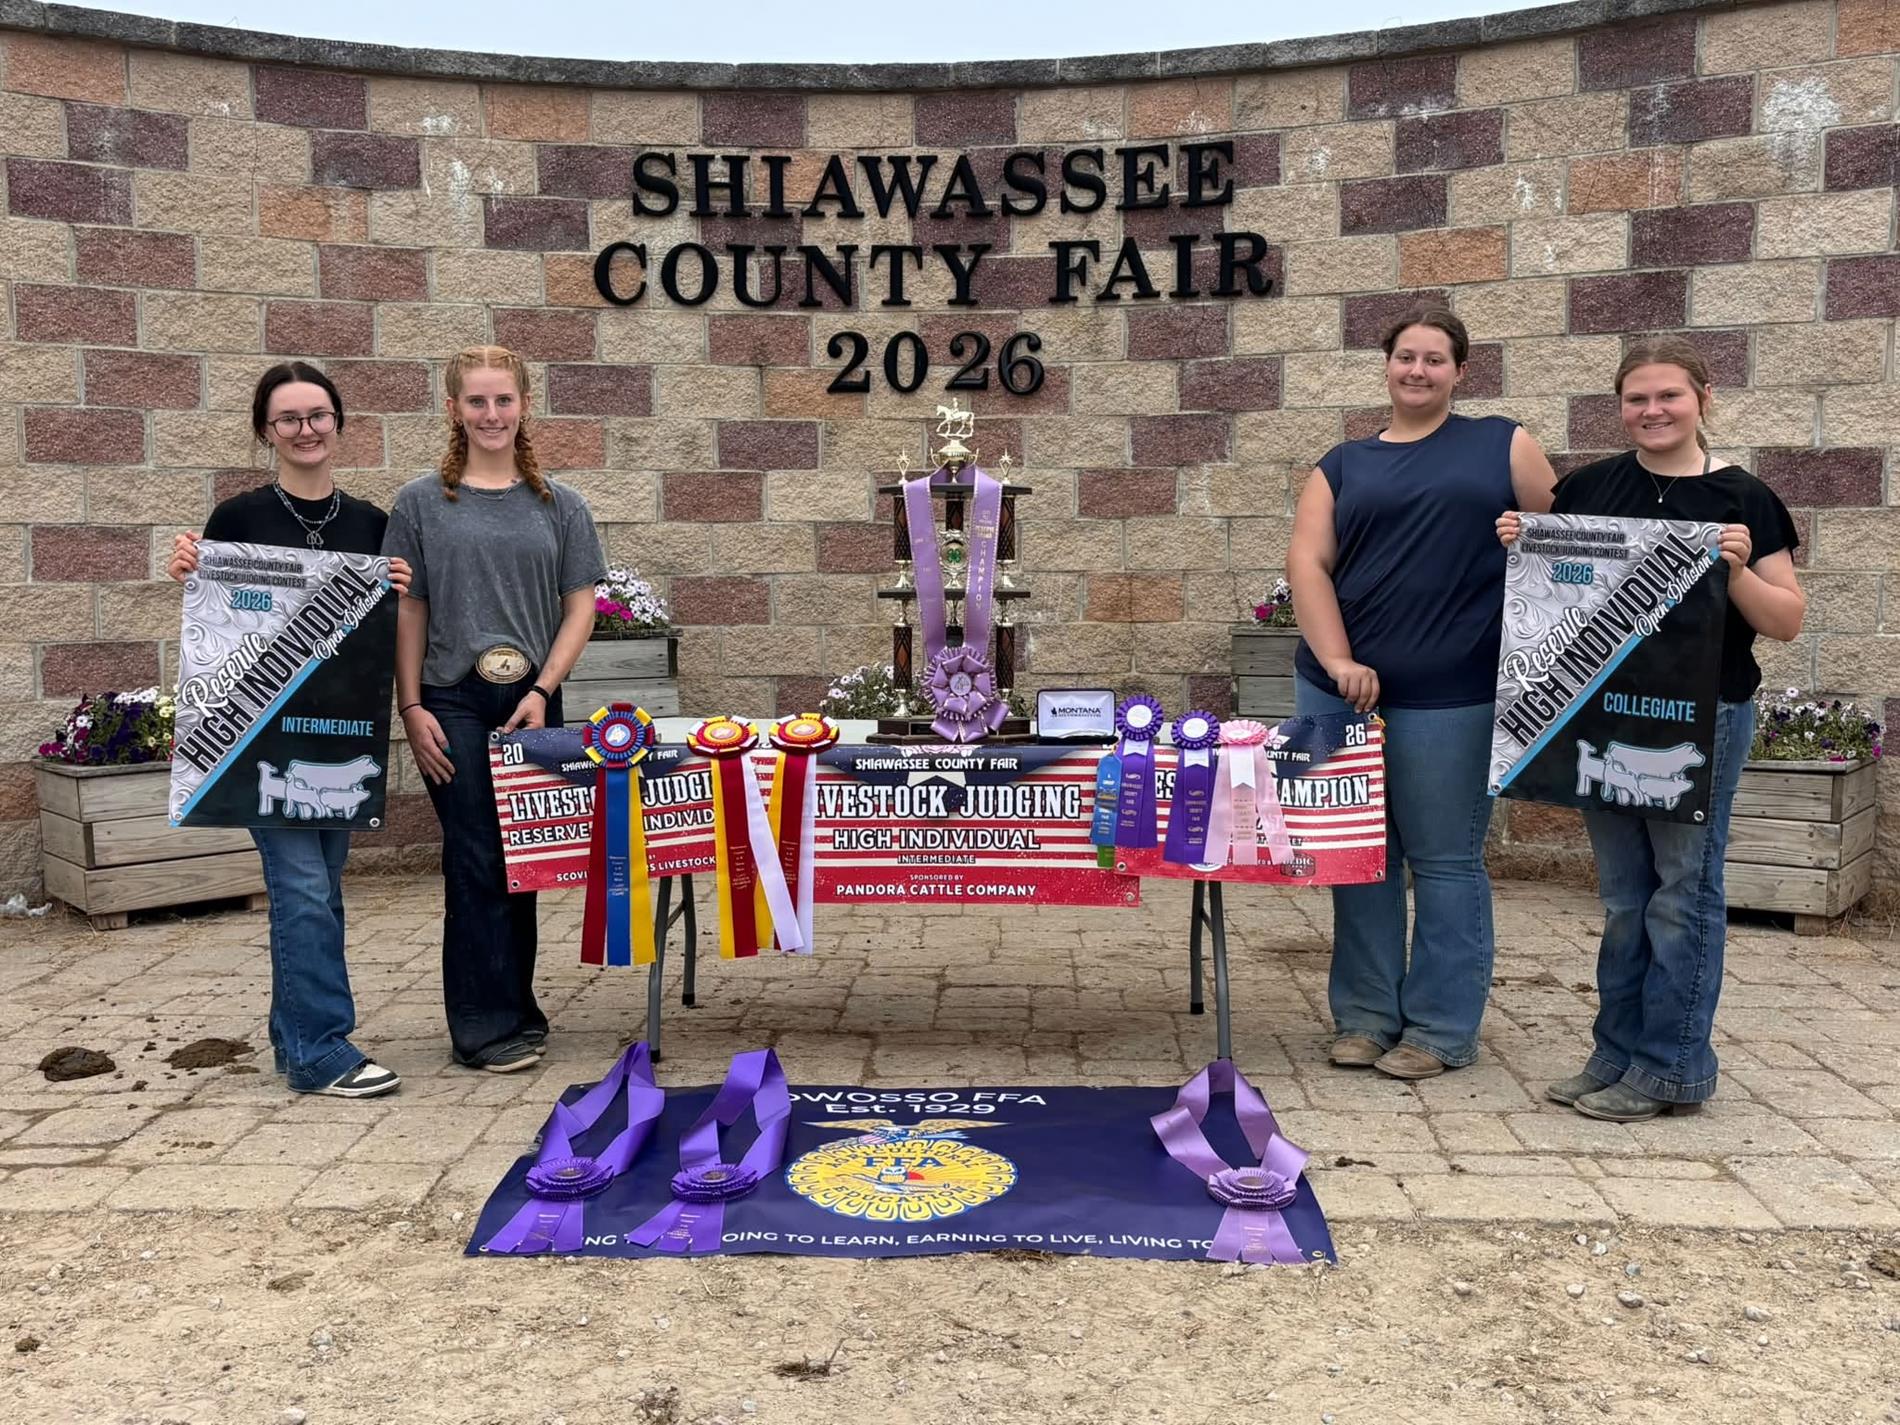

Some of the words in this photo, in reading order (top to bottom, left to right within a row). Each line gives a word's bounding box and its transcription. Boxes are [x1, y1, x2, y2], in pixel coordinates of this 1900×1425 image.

[632, 141, 1235, 219] SHIAWASSEE
[593, 241, 993, 308] COUNTY
[1047, 231, 1273, 301] FAIR
[826, 331, 1046, 395] 2026
[1527, 528, 1574, 540] SHIAWASSEE
[1576, 531, 1606, 543] COUNTY
[1607, 533, 1626, 544] FAIR
[1521, 543, 1560, 554] LIVESTOCK
[1562, 546, 1593, 557] JUDGING
[1594, 548, 1629, 559] CONTEST
[203, 555, 252, 568] SHIAWASSEE
[254, 558, 284, 572] COUNTY
[285, 562, 304, 574] FAIR
[1552, 562, 1593, 585] 2026
[199, 570, 238, 581] LIVESTOCK
[272, 577, 307, 589] CONTEST
[231, 589, 272, 612] 2026
[1634, 603, 1669, 636] Open
[1667, 556, 1714, 604] Division
[312, 628, 347, 660] Open
[344, 587, 386, 629] Division
[1498, 674, 1576, 748] HIGH
[1555, 532, 1707, 687] INDIVIDUAL
[1504, 607, 1587, 692] Reserve
[178, 697, 254, 774] HIGH
[235, 565, 380, 710] INDIVIDUAL
[181, 632, 268, 717] Reserve
[1603, 692, 1696, 723] COLLEGIATE
[282, 716, 374, 737] INTERMEDIATE
[1345, 723, 1366, 746] 26
[503, 742, 524, 765] 20
[657, 749, 679, 760] FAIR
[855, 758, 929, 771] SHIAWASSEE
[935, 757, 985, 770] COUNTY
[990, 757, 1018, 770] FAIR
[1266, 750, 1289, 761] UNTY
[1291, 752, 1311, 763] FAIR
[561, 760, 598, 772] SHIAWA
[509, 785, 597, 821] LIVEST
[643, 771, 713, 806] JUDGI
[815, 784, 948, 818] IVESTOCK
[959, 784, 1081, 818] JUDGING
[1274, 774, 1369, 808] AMPION
[509, 822, 590, 846] RESERVE
[643, 808, 715, 831] INDIVID
[834, 829, 892, 849] HIGH
[899, 829, 1040, 849] INDIVIDUAL
[658, 855, 716, 871] LIVESTOCK
[897, 855, 976, 864] INTERMEDIATE
[556, 870, 588, 882] SCOVI
[836, 884, 906, 896] PANDORA
[910, 884, 962, 896] CATTLE
[966, 884, 1036, 897] COMPANY
[825, 1103, 897, 1114] Est.
[908, 1103, 996, 1114] 1929
[973, 1092, 1047, 1106] FFA
[862, 1156, 945, 1168] FFA
[834, 1184, 967, 1203] EDUCATION
[721, 1231, 779, 1243] OING
[784, 1232, 815, 1244] TO
[821, 1234, 900, 1246] LEARN,
[906, 1232, 1007, 1244] EARNING
[1012, 1234, 1043, 1243] TO
[1050, 1233, 1104, 1245] LIVE,
[1110, 1234, 1182, 1249] LIVING
